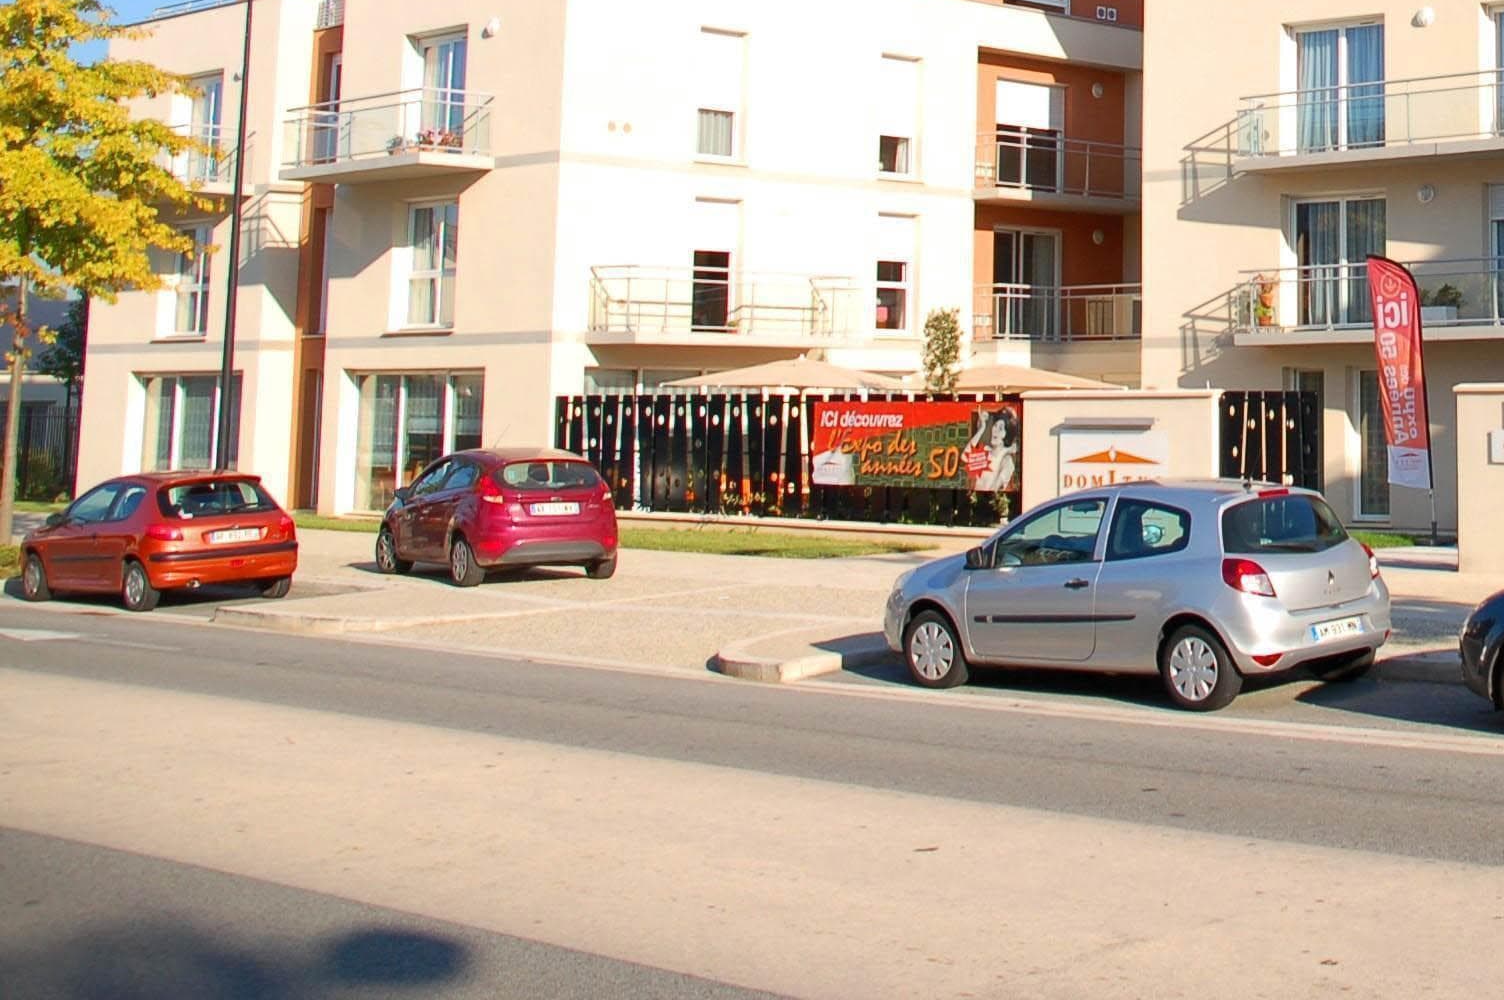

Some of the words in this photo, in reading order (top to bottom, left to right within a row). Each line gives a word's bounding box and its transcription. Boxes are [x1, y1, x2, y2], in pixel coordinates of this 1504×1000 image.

[820, 410, 839, 428] ICI
[840, 410, 904, 428] découvrez
[888, 430, 917, 456] des
[861, 456, 923, 477] années
[928, 445, 960, 480] 50
